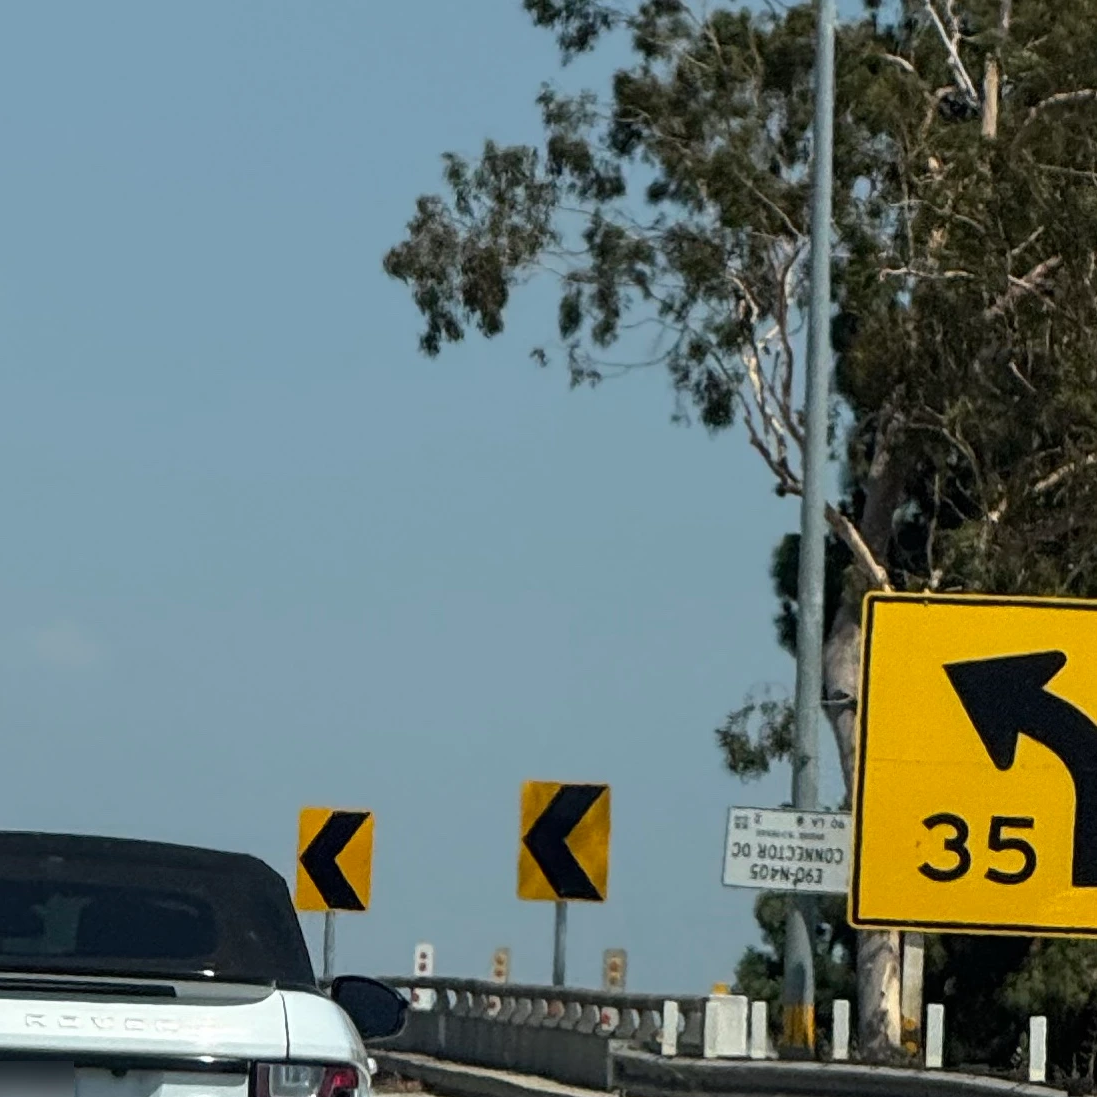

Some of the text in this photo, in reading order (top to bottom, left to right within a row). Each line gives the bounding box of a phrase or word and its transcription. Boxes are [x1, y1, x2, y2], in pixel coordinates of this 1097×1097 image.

[731, 841, 844, 864] CONNECTOR OC
[917, 812, 1038, 886] 35
